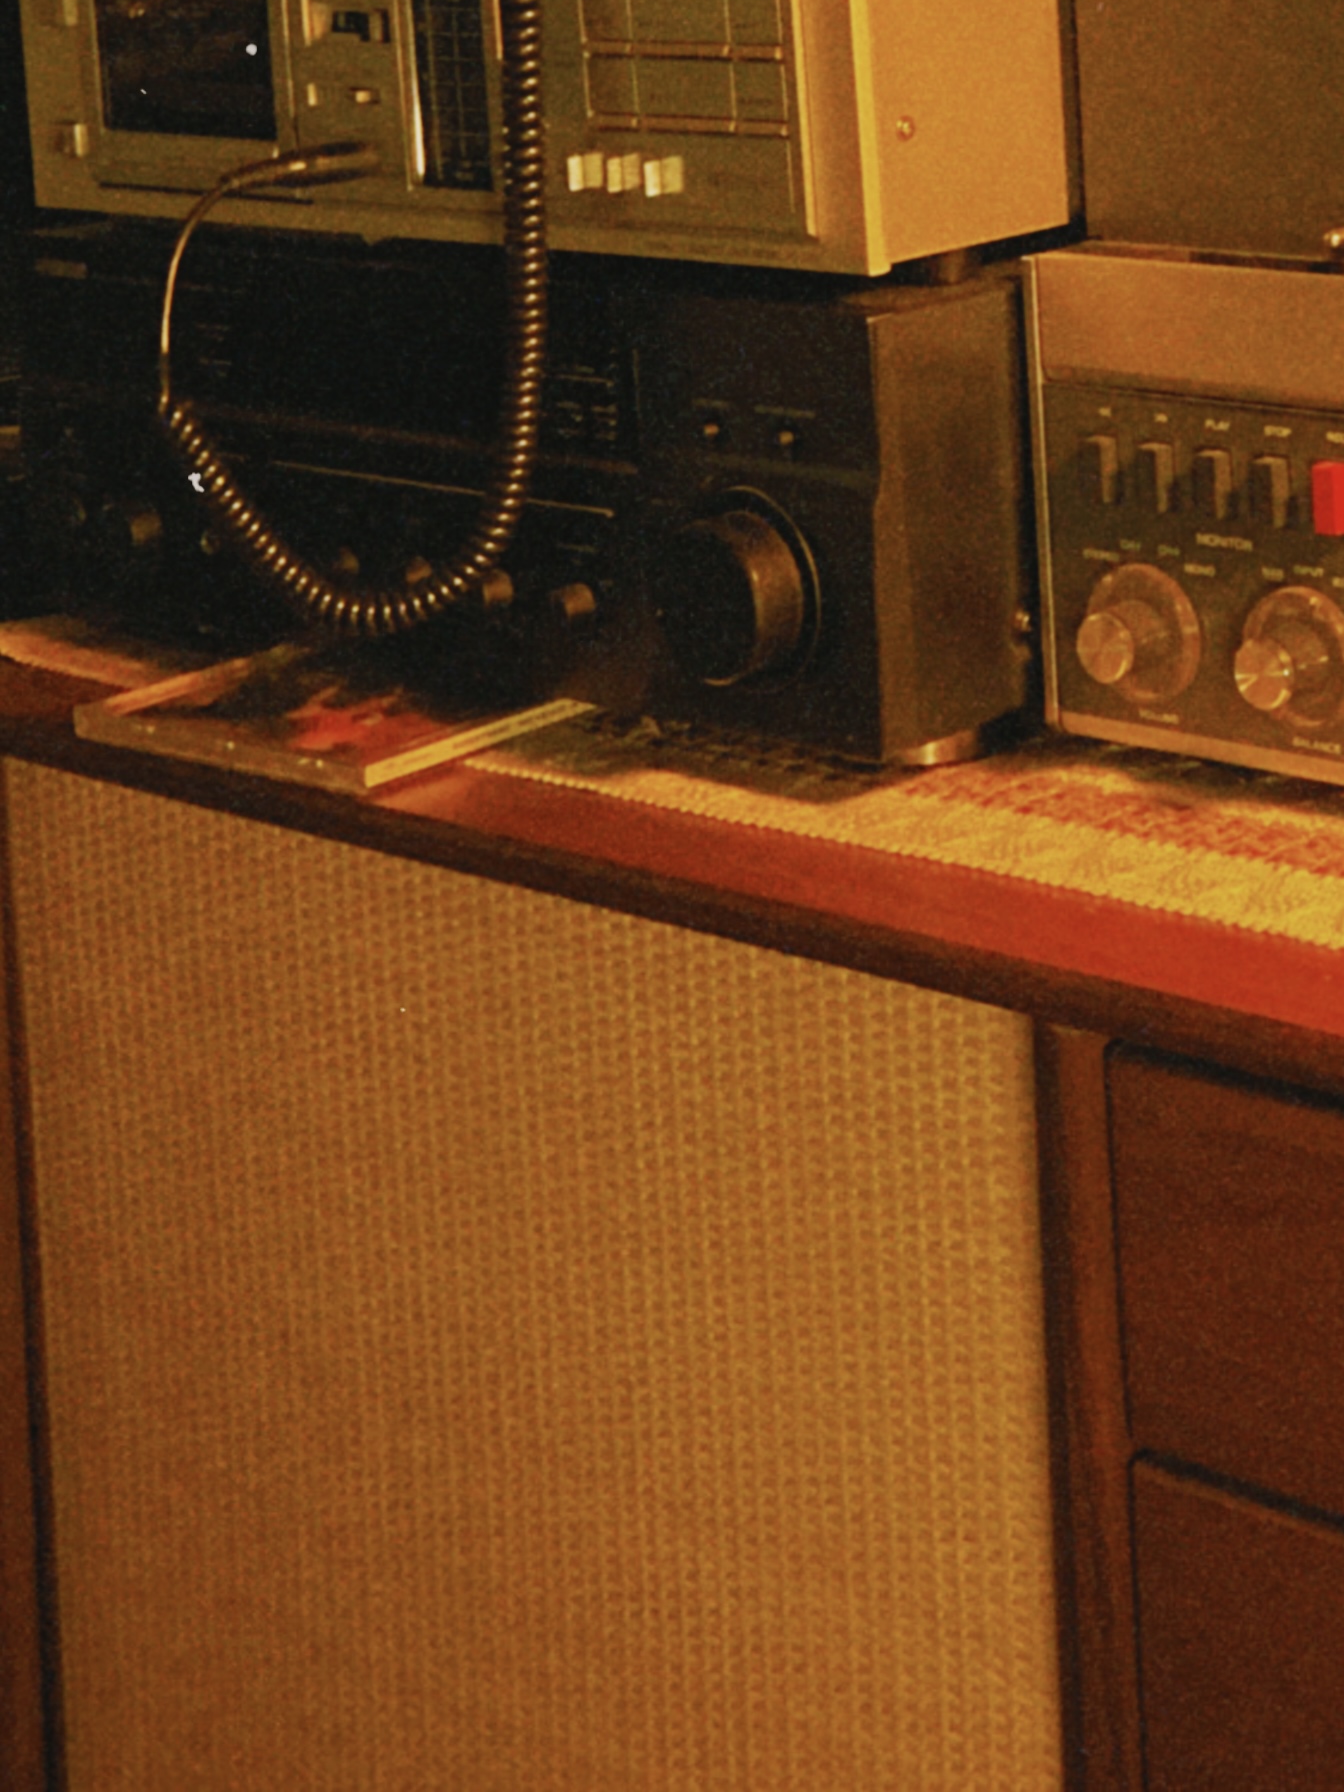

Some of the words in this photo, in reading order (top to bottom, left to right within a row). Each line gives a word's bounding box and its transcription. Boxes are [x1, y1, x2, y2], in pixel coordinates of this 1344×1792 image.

[1205, 418, 1230, 432] PLAY
[1263, 424, 1292, 439] STOP
[1195, 531, 1254, 552] MONITOR
[1291, 735, 1342, 755] BALANCE
